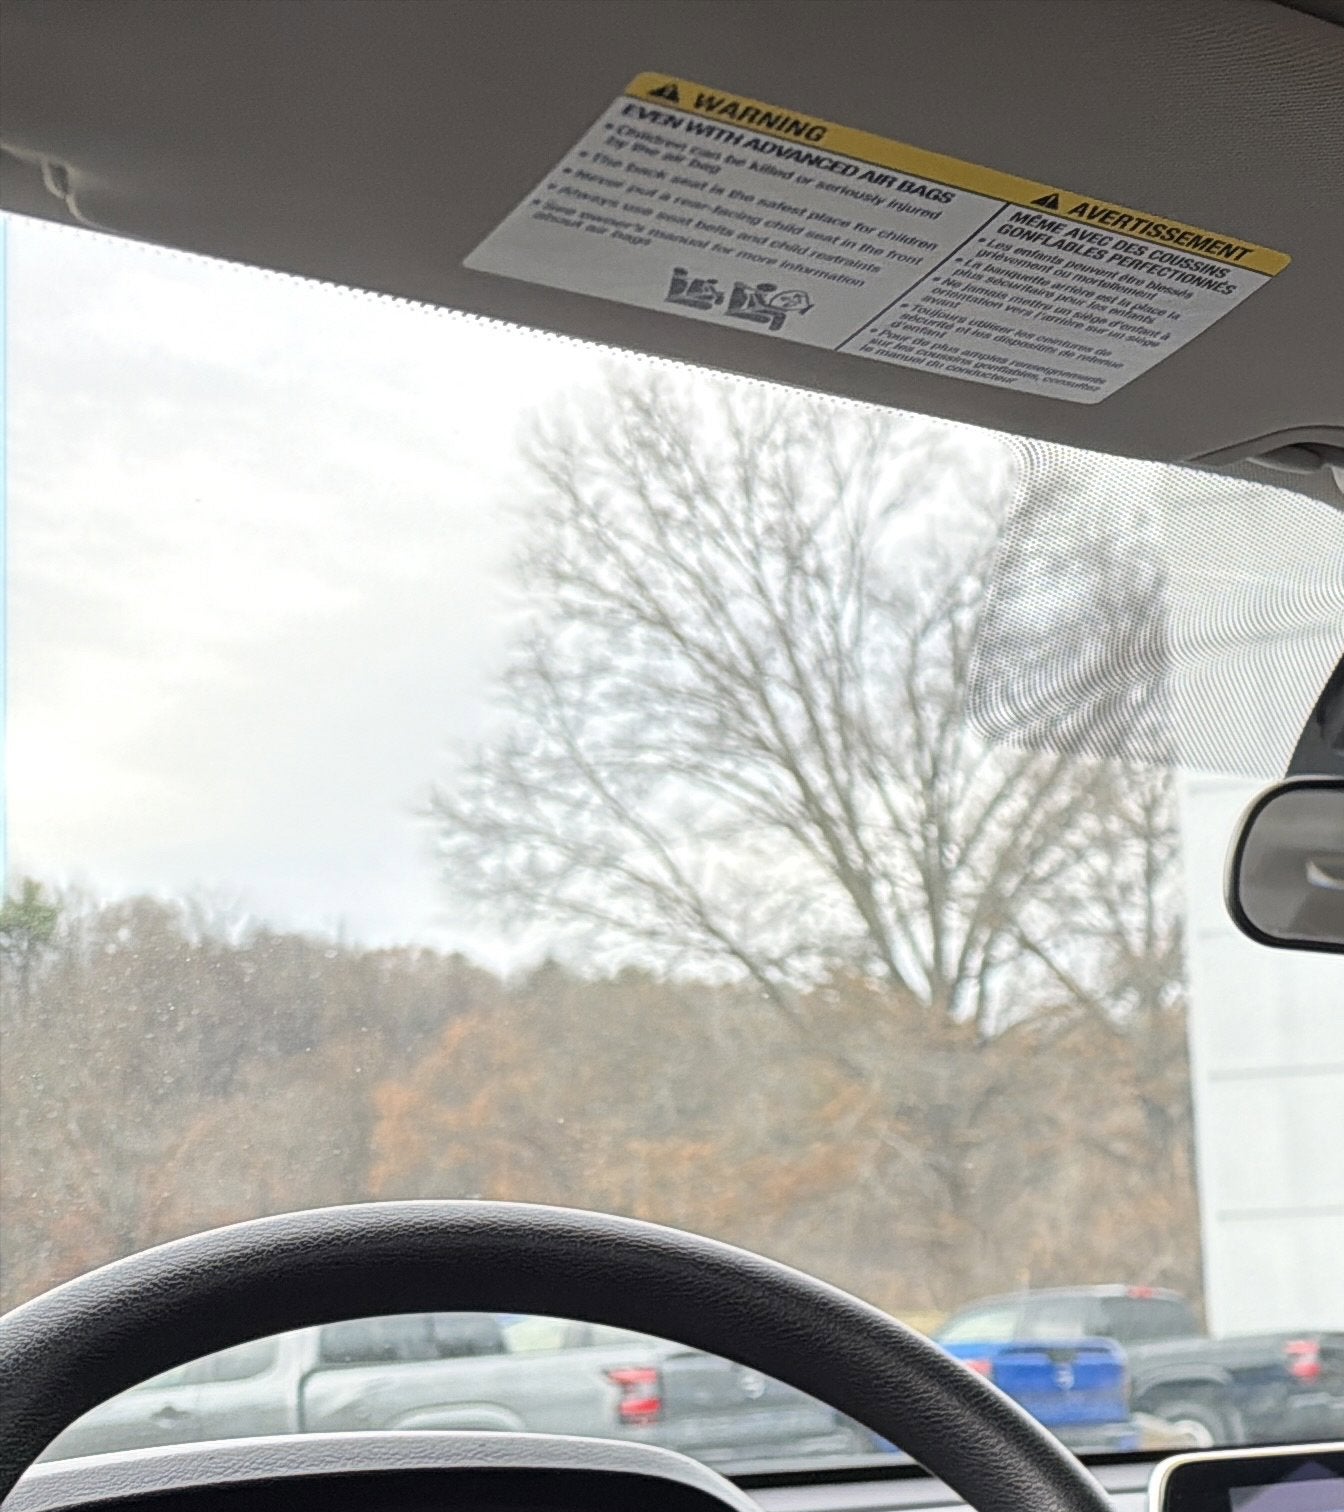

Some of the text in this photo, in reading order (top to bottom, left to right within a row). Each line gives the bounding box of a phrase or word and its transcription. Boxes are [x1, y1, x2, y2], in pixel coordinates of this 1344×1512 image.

[693, 92, 827, 142] WARNING
[621, 103, 955, 203] EVEN WITH ADVANCED AIR BAGS
[747, 160, 795, 180] killed
[814, 180, 886, 206] seriously
[886, 198, 943, 220] injured
[756, 198, 808, 216] safest
[805, 211, 851, 227] place
[852, 222, 876, 234] for
[876, 229, 938, 250] children
[763, 219, 805, 235] child
[804, 230, 841, 244] seat
[857, 242, 884, 255] the
[885, 249, 924, 265] front
[1008, 210, 1231, 278] MÊME AVEC DES COUSSINS
[1066, 201, 1254, 261] AVERTISSEMENT
[768, 239, 810, 255] child
[807, 250, 881, 273] restraints
[778, 259, 865, 287] information
[985, 238, 1013, 252] Les
[1012, 247, 1065, 265] enfants
[1061, 259, 1120, 279] peuvent
[996, 223, 1237, 295] GONFLABLES PERFECTIONNÉS
[1052, 268, 1072, 278] ou
